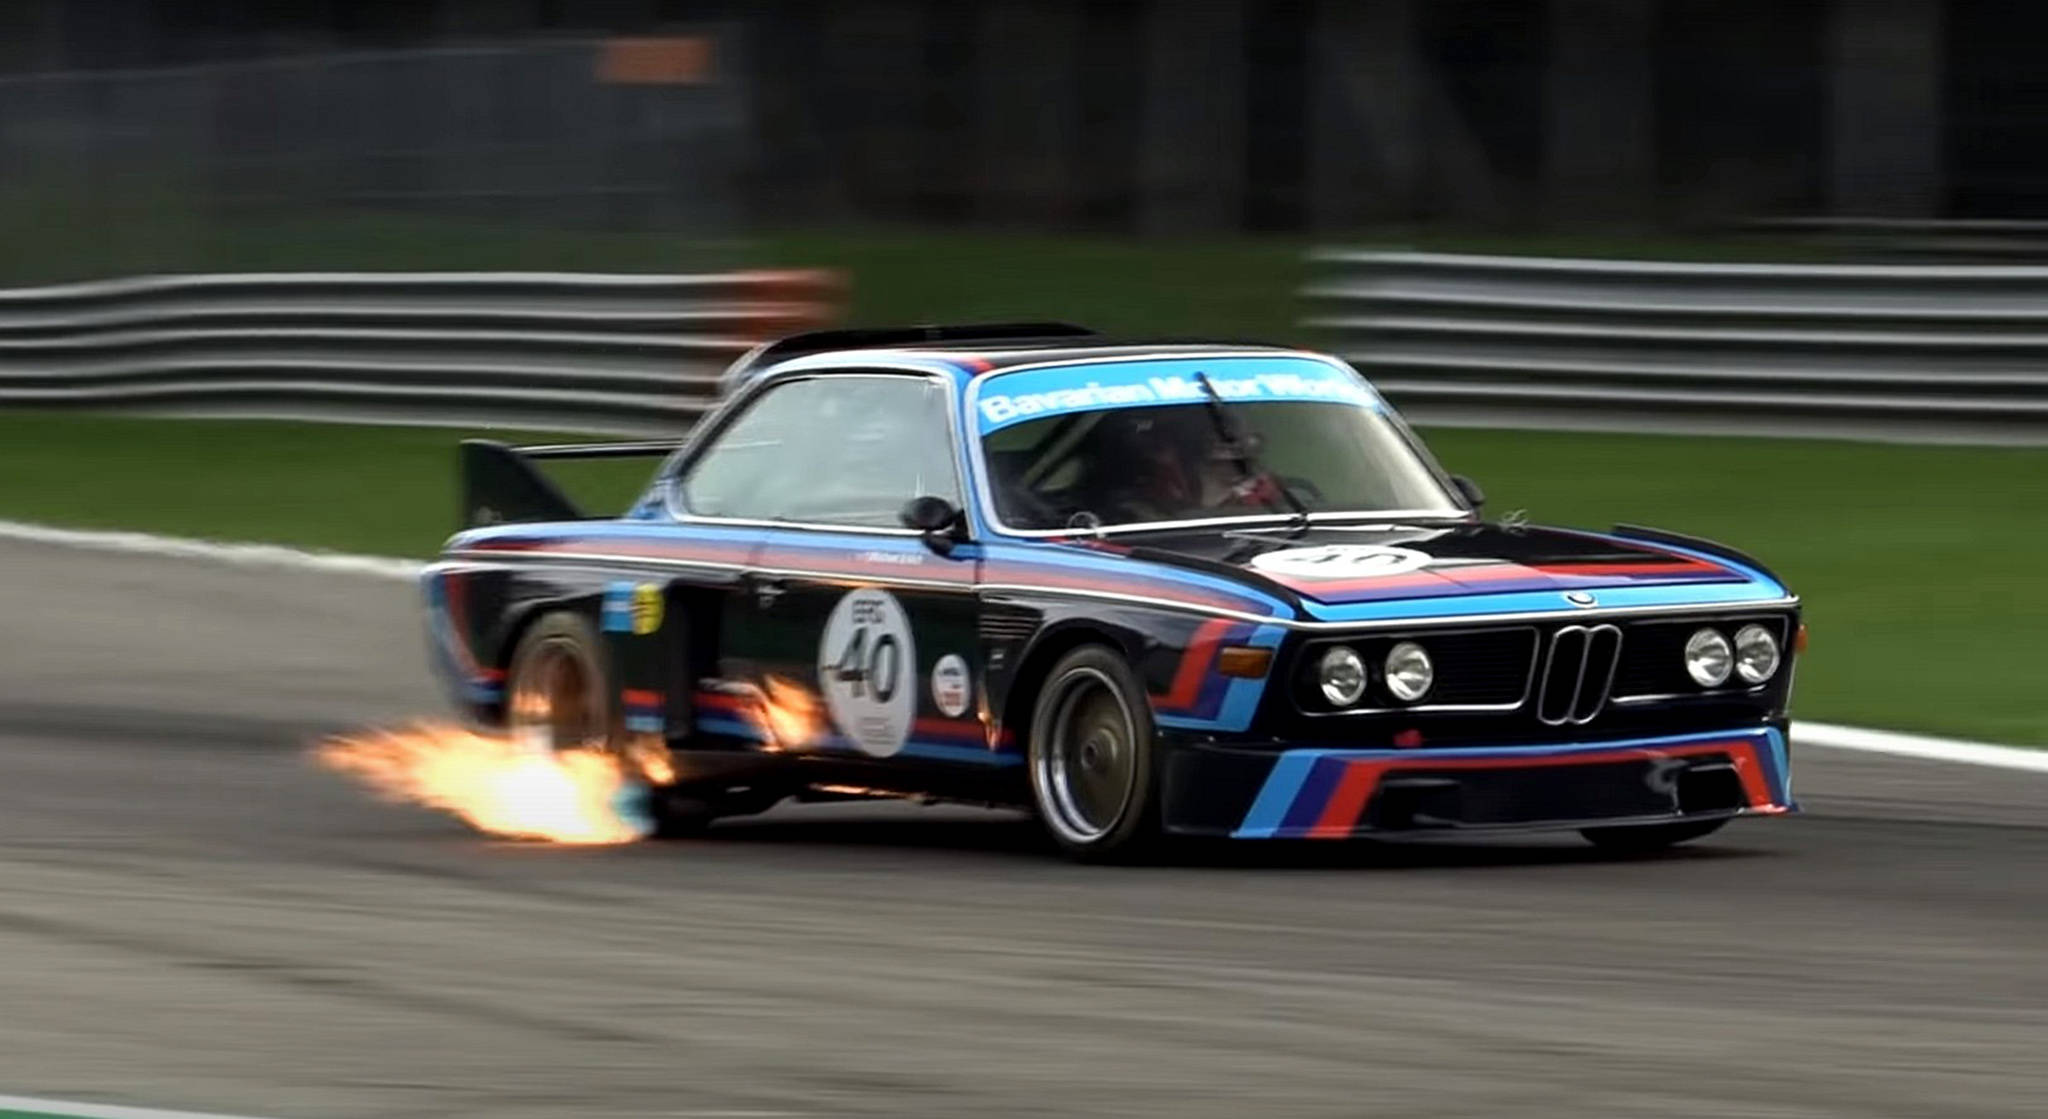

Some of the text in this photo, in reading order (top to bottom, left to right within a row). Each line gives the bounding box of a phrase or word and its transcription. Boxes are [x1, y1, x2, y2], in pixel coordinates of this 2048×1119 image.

[978, 383, 1156, 422] Bavarian
[1147, 375, 1259, 398] Moor
[824, 627, 899, 703] 40
